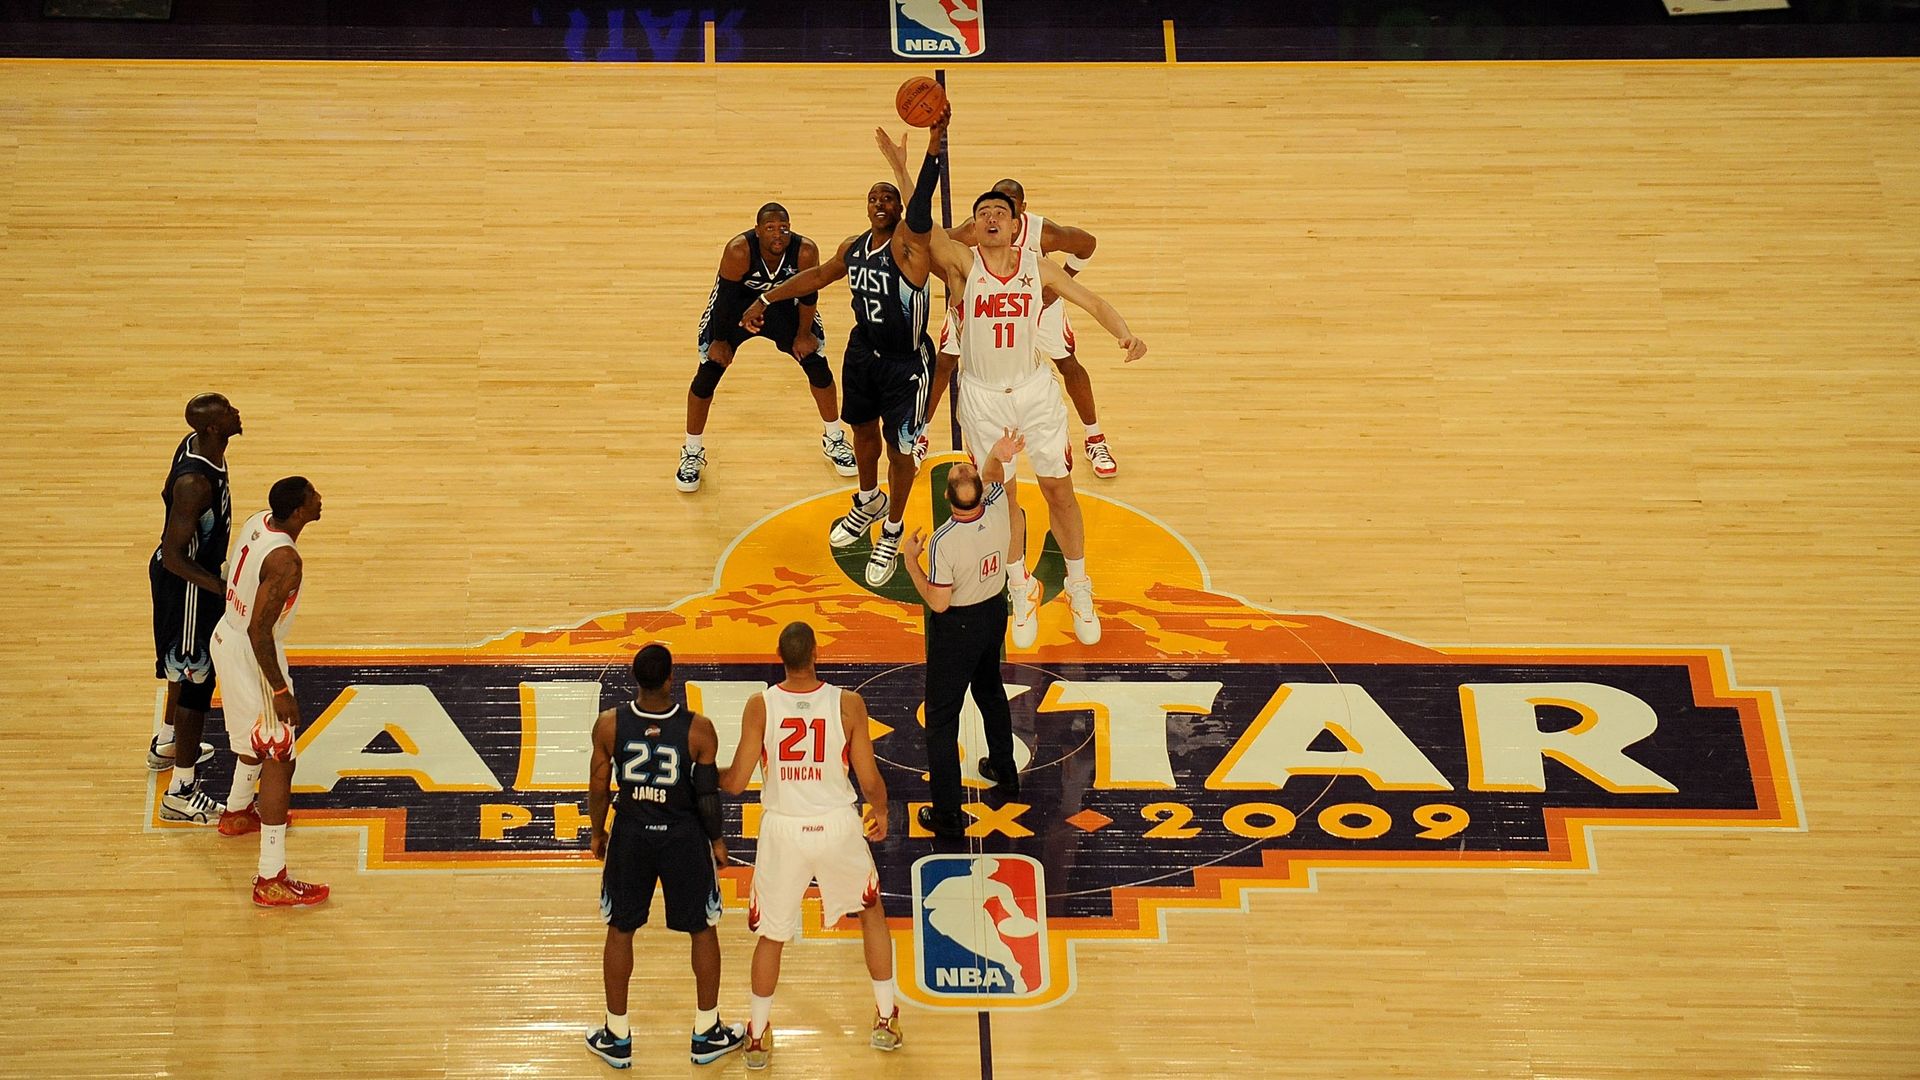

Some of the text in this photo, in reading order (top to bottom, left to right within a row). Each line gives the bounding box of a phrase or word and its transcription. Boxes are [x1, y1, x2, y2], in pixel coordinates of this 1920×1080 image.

[905, 39, 955, 51] NBA
[848, 266, 890, 295] EAST
[863, 297, 883, 322] 12
[974, 293, 1032, 318] WEST
[992, 322, 1015, 348] 11
[232, 545, 249, 586] 1
[982, 555, 997, 577] 44
[779, 717, 826, 763] 21
[622, 740, 680, 786] 23
[780, 766, 822, 781] DUNCAN
[632, 785, 666, 804] JAMES
[1141, 803, 1470, 840] 2009
[936, 967, 1007, 988] NBA
